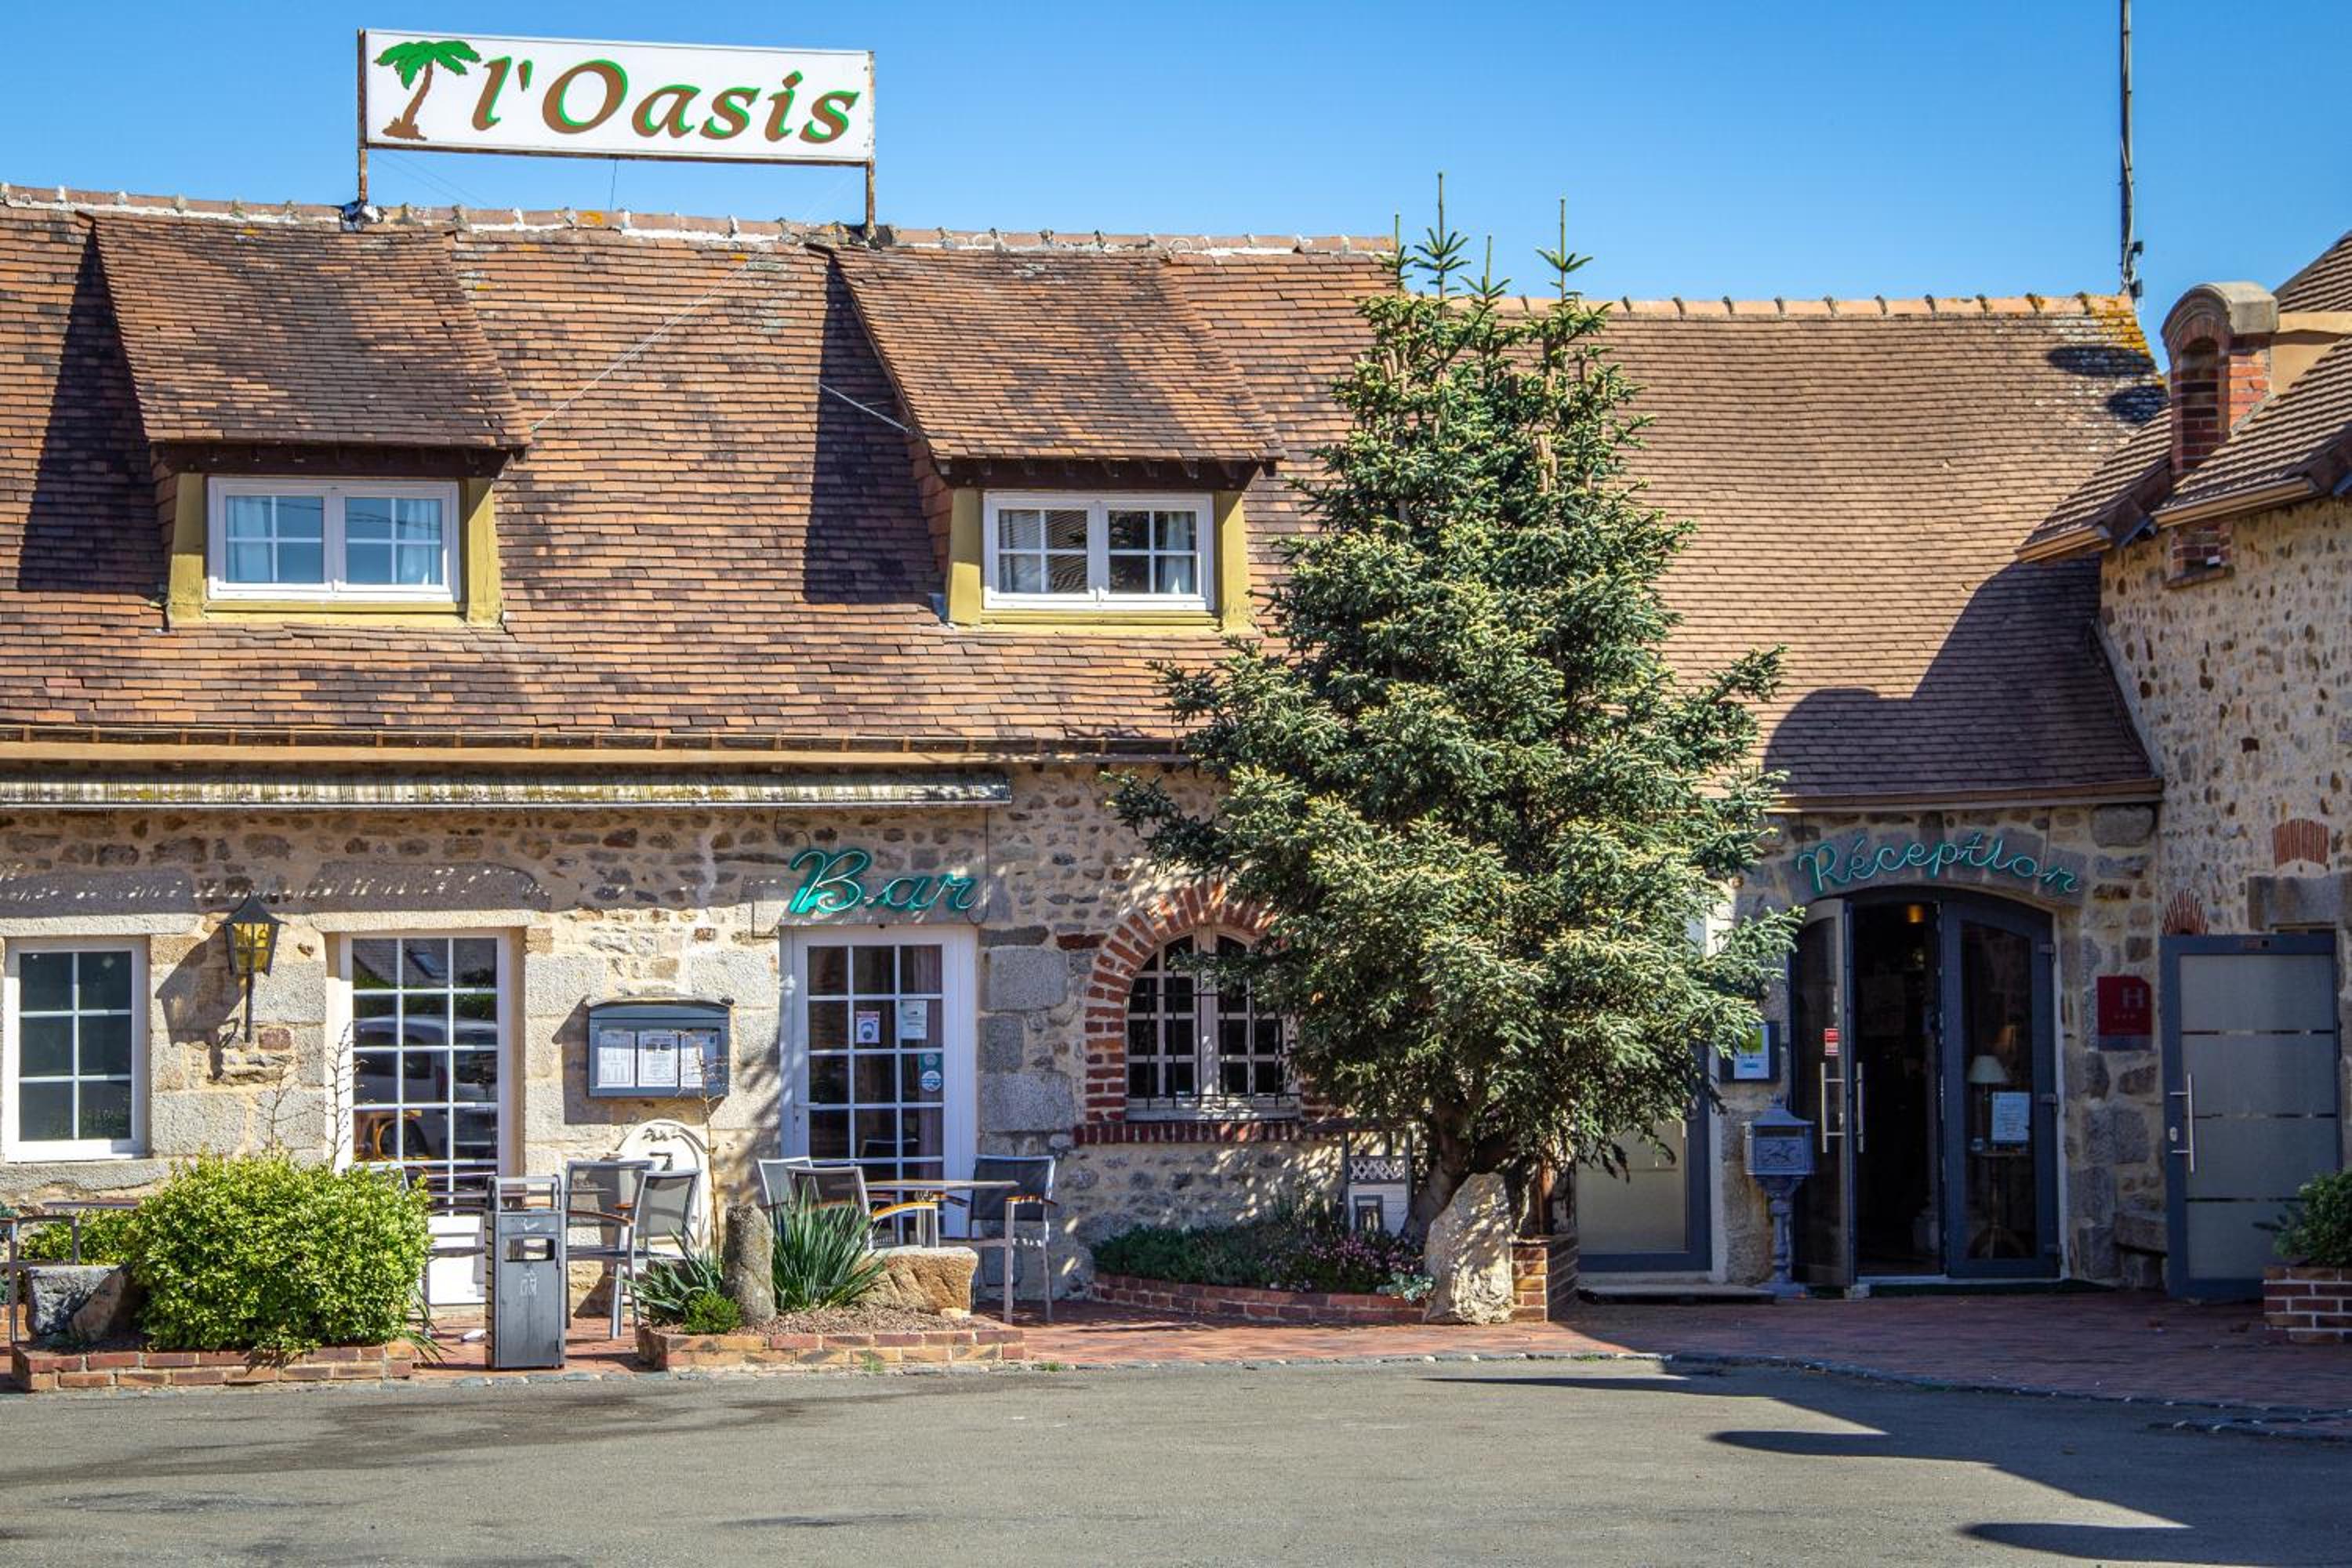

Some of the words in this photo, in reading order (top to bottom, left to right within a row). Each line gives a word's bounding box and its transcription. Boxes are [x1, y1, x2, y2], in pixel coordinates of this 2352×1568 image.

[472, 56, 860, 143] l'Oasis
[789, 848, 978, 914] Bar
[1797, 831, 2080, 892] Réception
[2122, 987, 2145, 1009] H
